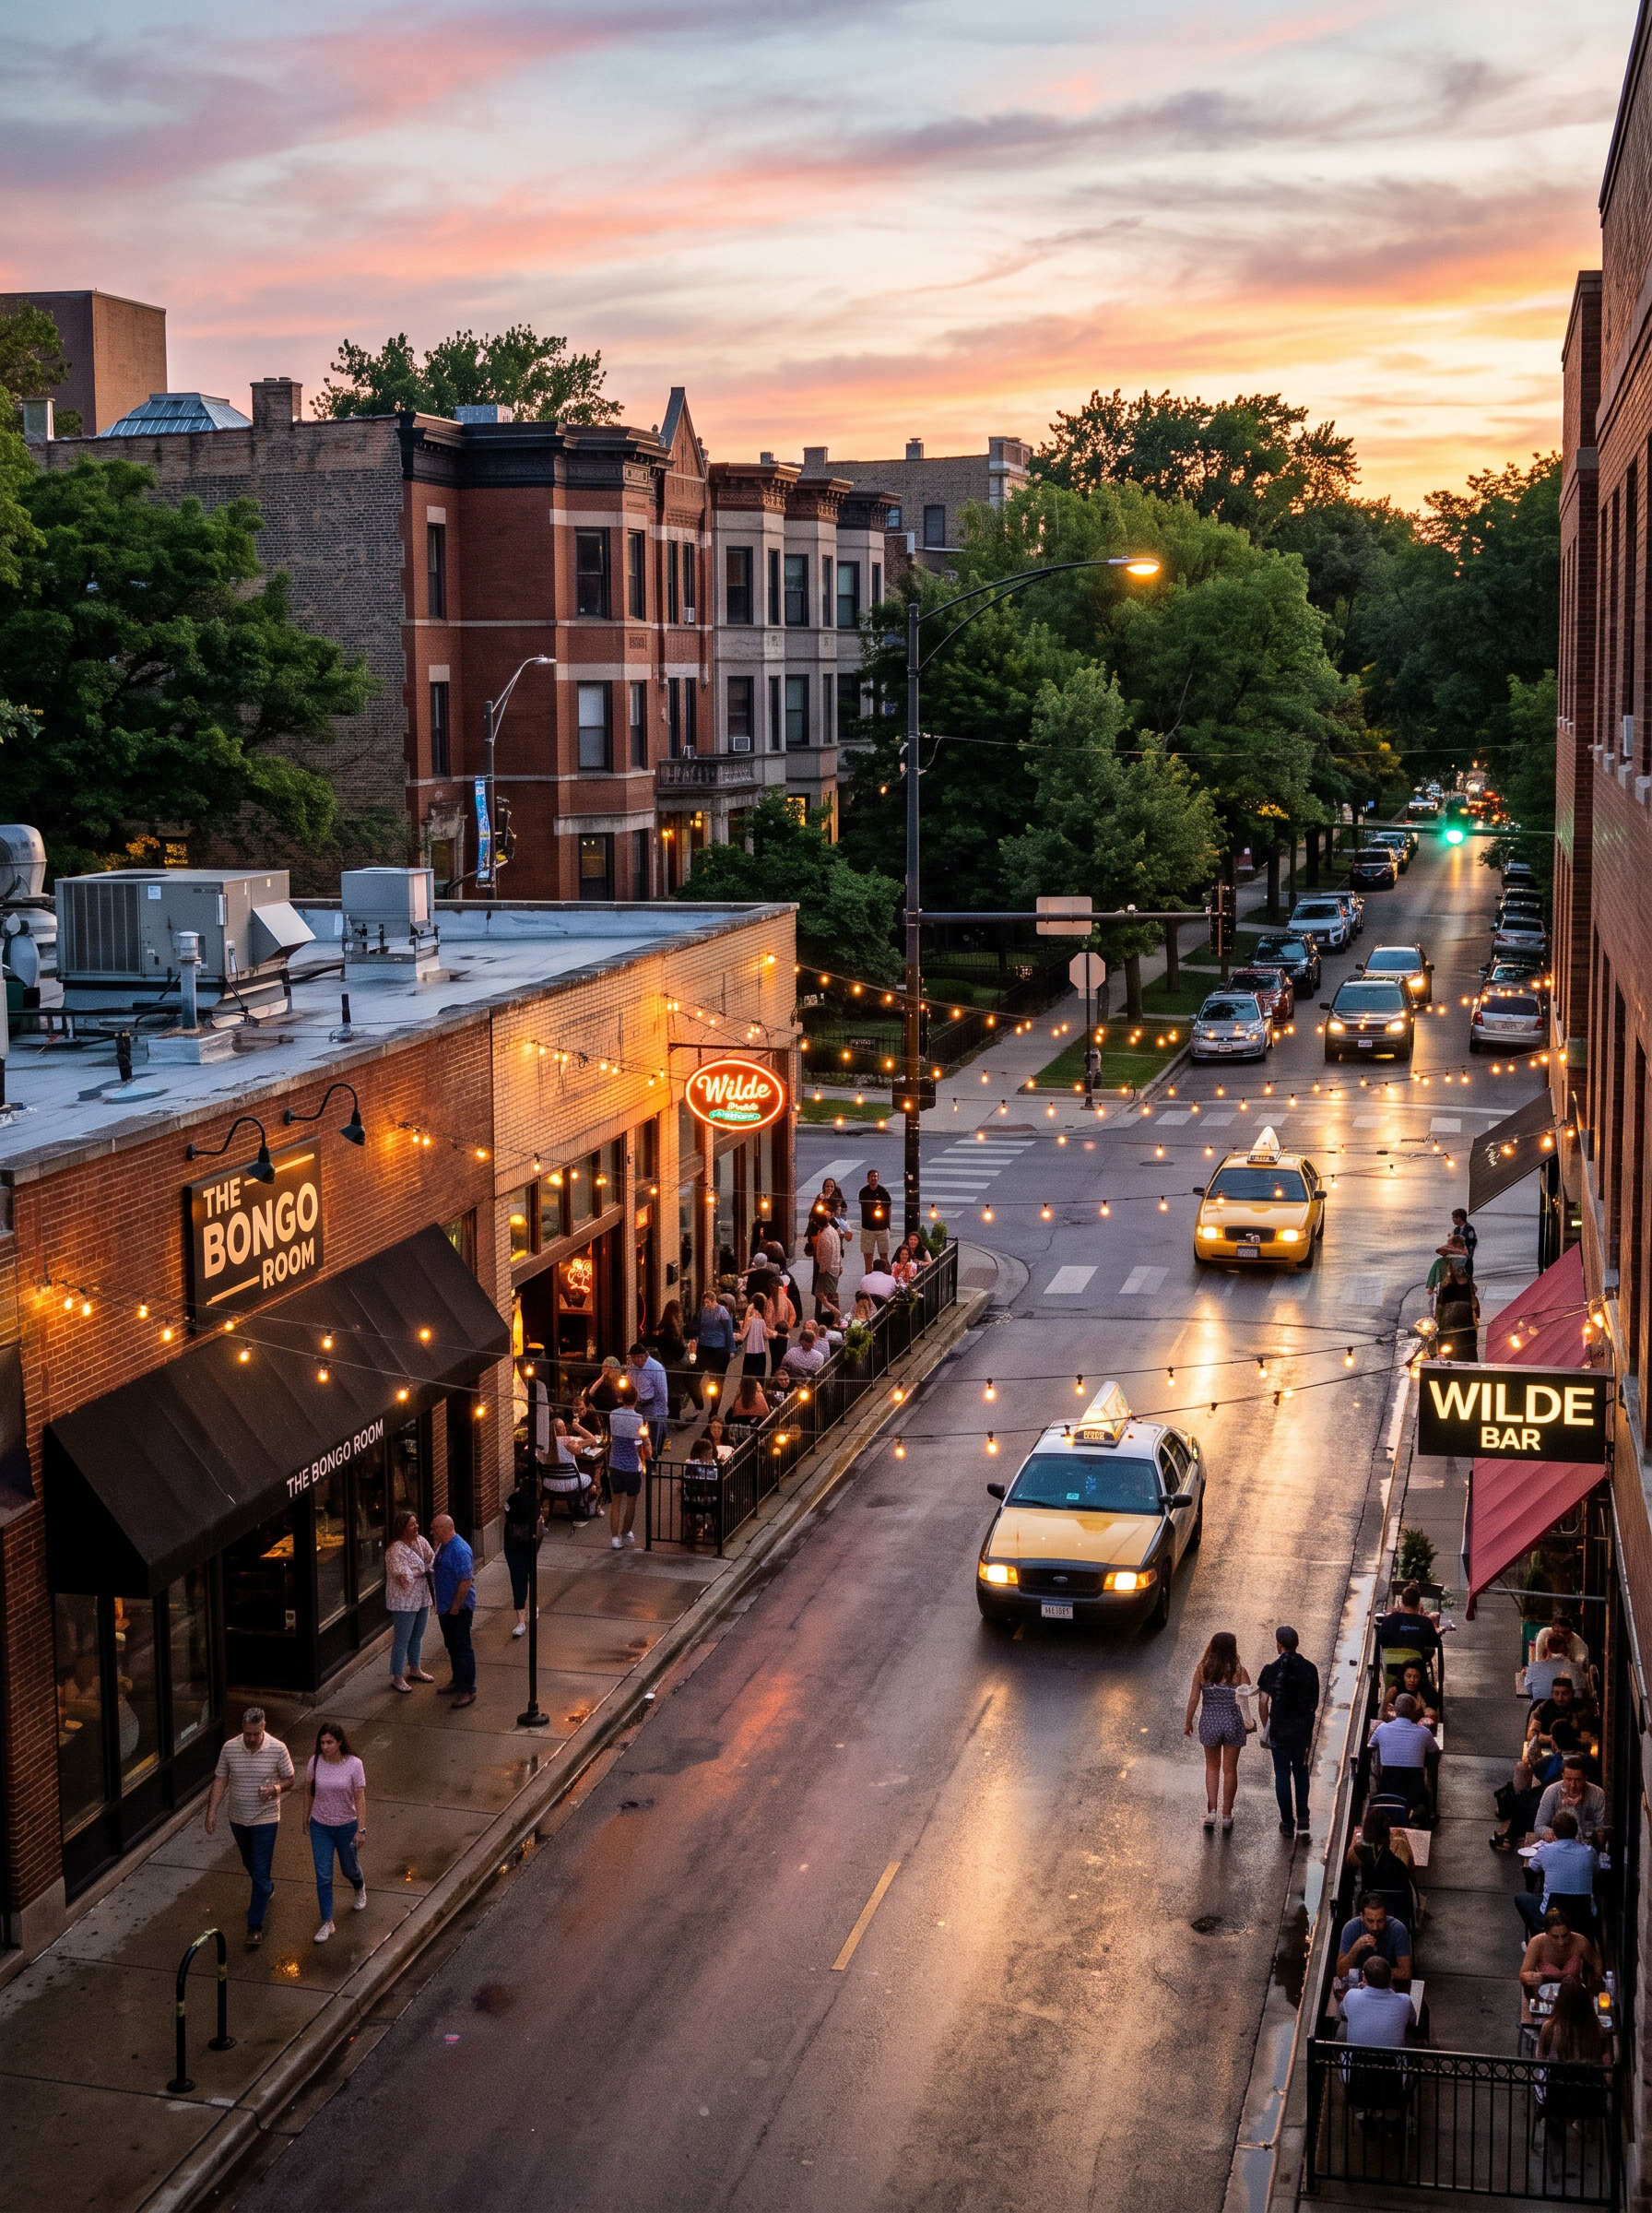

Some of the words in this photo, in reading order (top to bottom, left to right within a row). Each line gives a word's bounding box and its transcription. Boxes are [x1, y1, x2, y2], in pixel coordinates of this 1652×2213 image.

[696, 1073, 772, 1104] Wilde
[203, 1177, 242, 1218] THE
[203, 1182, 319, 1279] BONGO
[262, 1237, 315, 1290] ROOM
[1428, 1380, 1595, 1426] WILDE
[286, 1467, 310, 1498] THE
[312, 1440, 351, 1483] BONGO
[353, 1418, 384, 1455] ROOM
[1481, 1426, 1541, 1450] BAR
